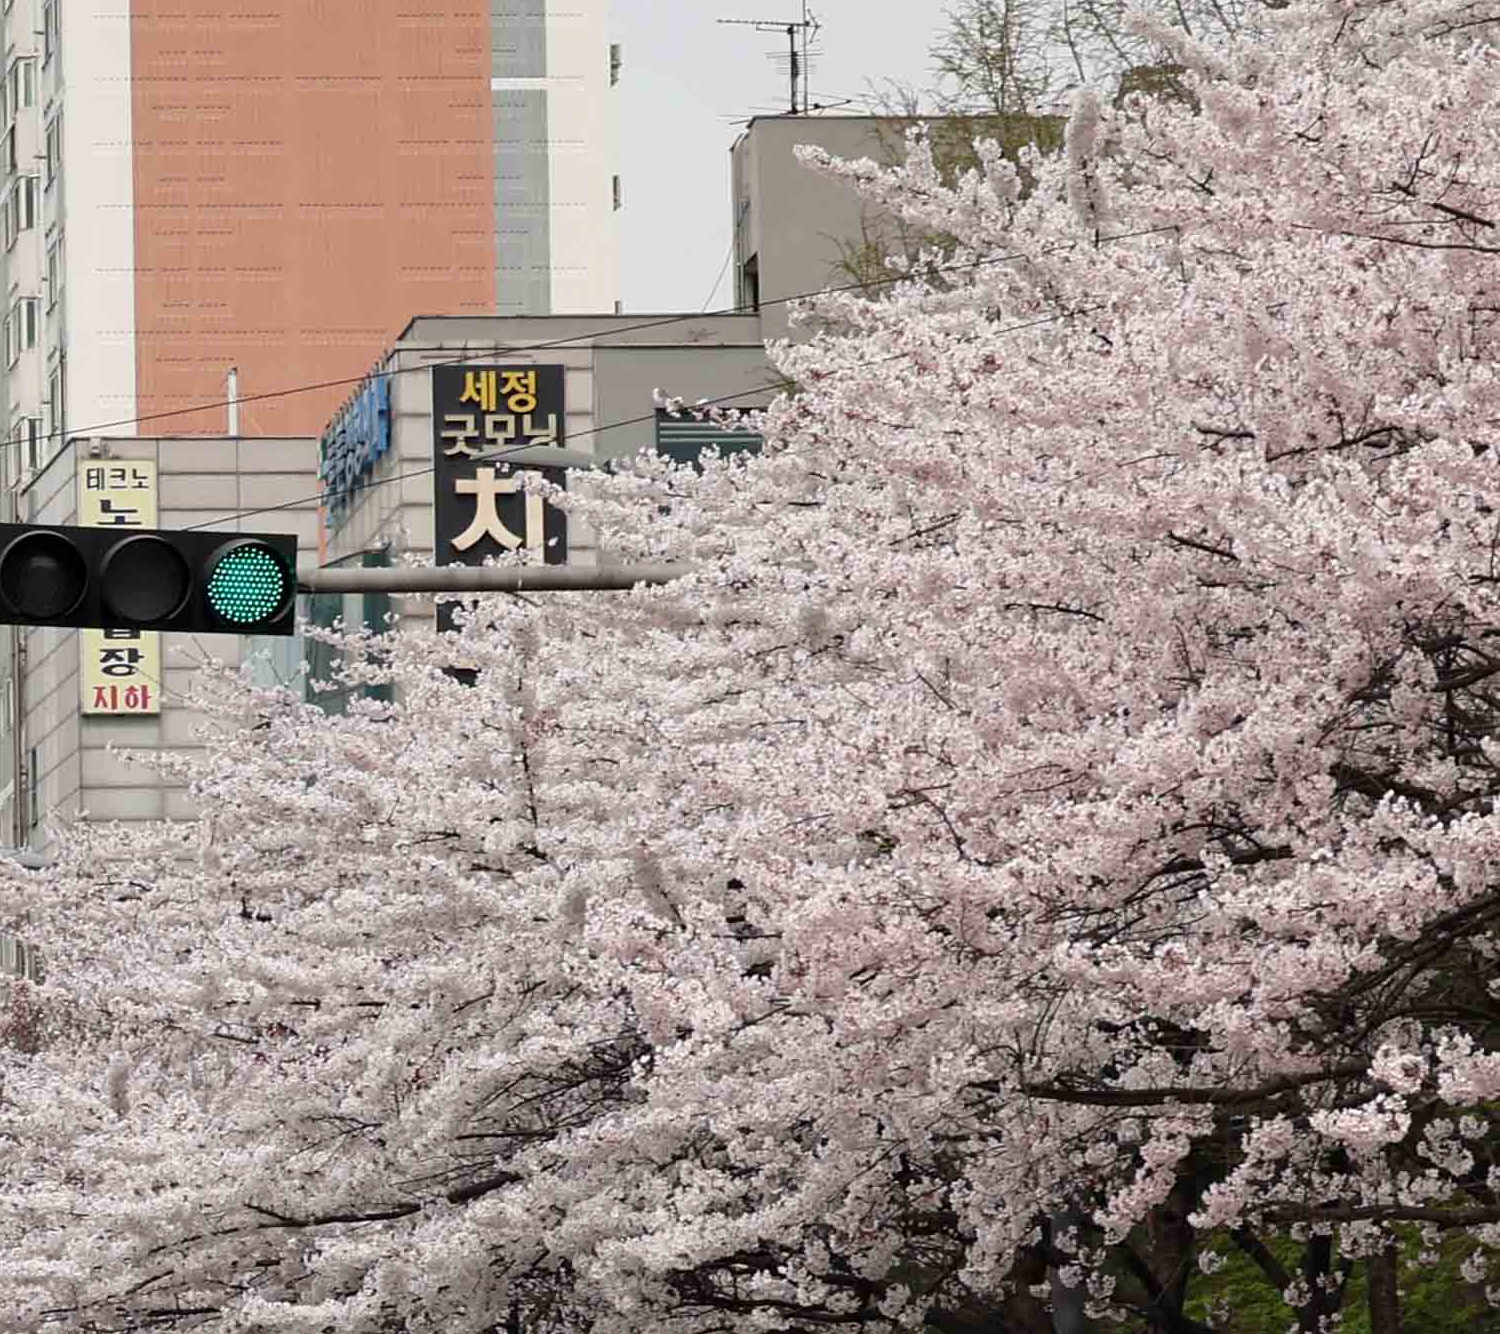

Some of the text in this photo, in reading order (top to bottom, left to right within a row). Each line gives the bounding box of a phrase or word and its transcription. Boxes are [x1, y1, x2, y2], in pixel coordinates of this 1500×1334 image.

[459, 370, 538, 414] 세정
[85, 466, 150, 491] 테크노
[93, 684, 152, 710] 지하
